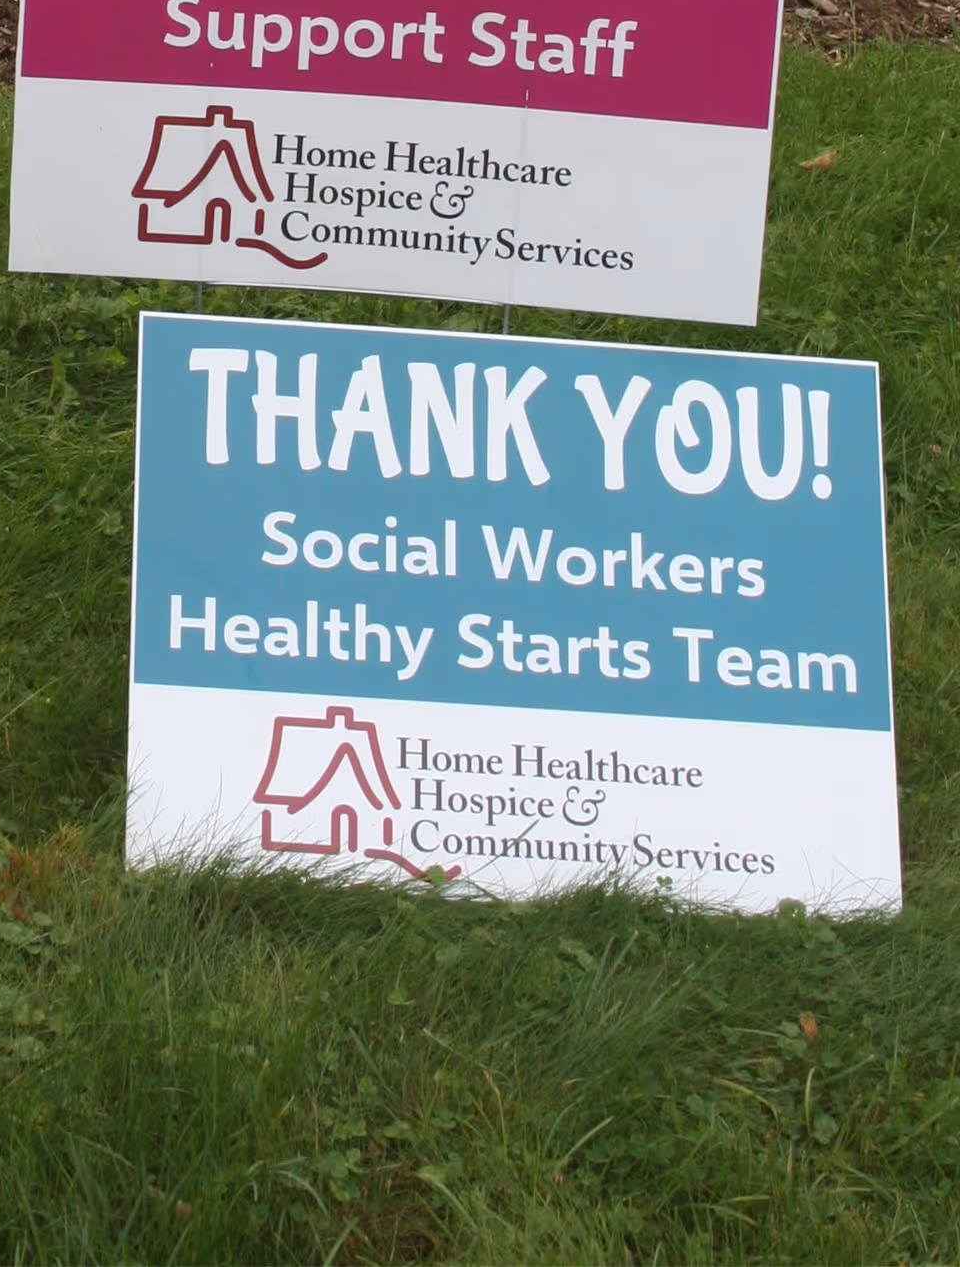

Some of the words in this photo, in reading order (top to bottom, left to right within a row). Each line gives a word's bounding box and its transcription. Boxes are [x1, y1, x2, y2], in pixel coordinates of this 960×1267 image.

[468, 12, 637, 77] Staff
[272, 134, 375, 169] Home
[384, 141, 571, 186] Healthcare
[284, 172, 422, 217] Hospice
[430, 181, 474, 219] &
[281, 211, 491, 265] Community
[495, 228, 633, 270] Services
[189, 348, 550, 486] THANK
[575, 375, 832, 500] YOU!
[262, 511, 456, 576] Social
[482, 526, 765, 597] Workers
[170, 595, 434, 680] Healthy
[458, 614, 650, 679] Starts
[673, 628, 857, 693] Team
[397, 738, 502, 775] Home
[512, 745, 702, 787] Healthcare
[412, 778, 554, 826] Hospice
[563, 786, 606, 826] &
[410, 819, 629, 869] Community
[632, 834, 775, 875] Services
